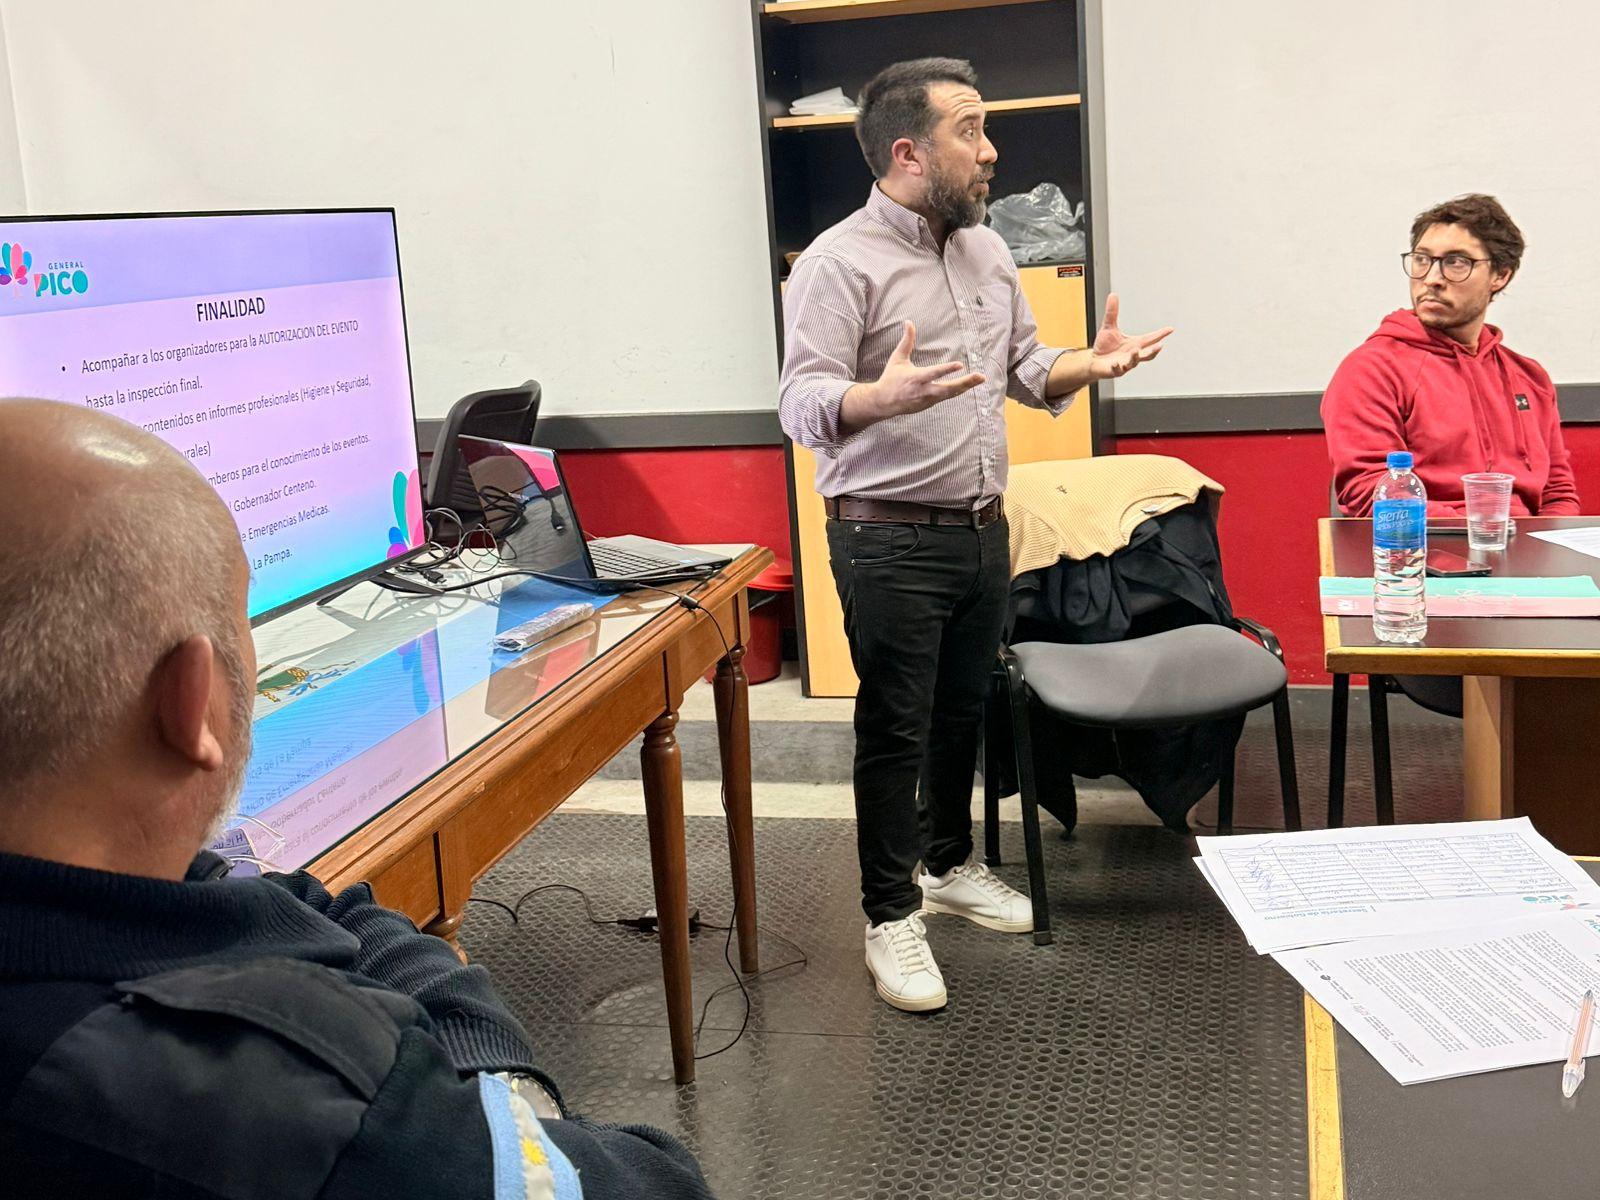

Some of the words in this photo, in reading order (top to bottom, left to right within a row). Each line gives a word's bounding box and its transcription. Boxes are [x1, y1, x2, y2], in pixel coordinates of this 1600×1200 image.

[48, 261, 84, 270] GENERAL
[34, 270, 88, 297] PICO
[196, 297, 266, 322] FINALIDAD
[82, 353, 139, 374] Acompañar
[142, 354, 148, 364] a
[150, 348, 164, 363] los
[166, 340, 228, 362] organizadores
[230, 338, 248, 352] para
[249, 335, 257, 347] la
[258, 326, 316, 346] AUTORIZACION
[317, 325, 330, 337] DEL
[331, 320, 359, 335] EVENTO
[85, 394, 115, 409] hasta
[116, 390, 126, 404] la
[127, 380, 179, 402] inspección
[180, 376, 204, 392] final.
[142, 412, 194, 433] contenidos
[196, 411, 208, 423] en
[208, 404, 247, 421] informes
[248, 391, 300, 414] profesionales
[300, 384, 330, 403] (Higiene
[331, 384, 336, 396] y
[336, 374, 372, 393] Seguridad,
[208, 469, 240, 487] mberos
[242, 463, 260, 480] para
[261, 458, 269, 472] el
[270, 448, 321, 470] conocimiento
[321, 443, 332, 455] de
[332, 440, 342, 452] los
[343, 433, 371, 449] eventos.
[233, 488, 283, 512] Gobernador
[283, 479, 317, 497] Centeno.
[248, 514, 298, 540] Emergencias
[1377, 509, 1409, 524] Sierra
[253, 558, 263, 570] La
[264, 548, 293, 567] Pampa.
